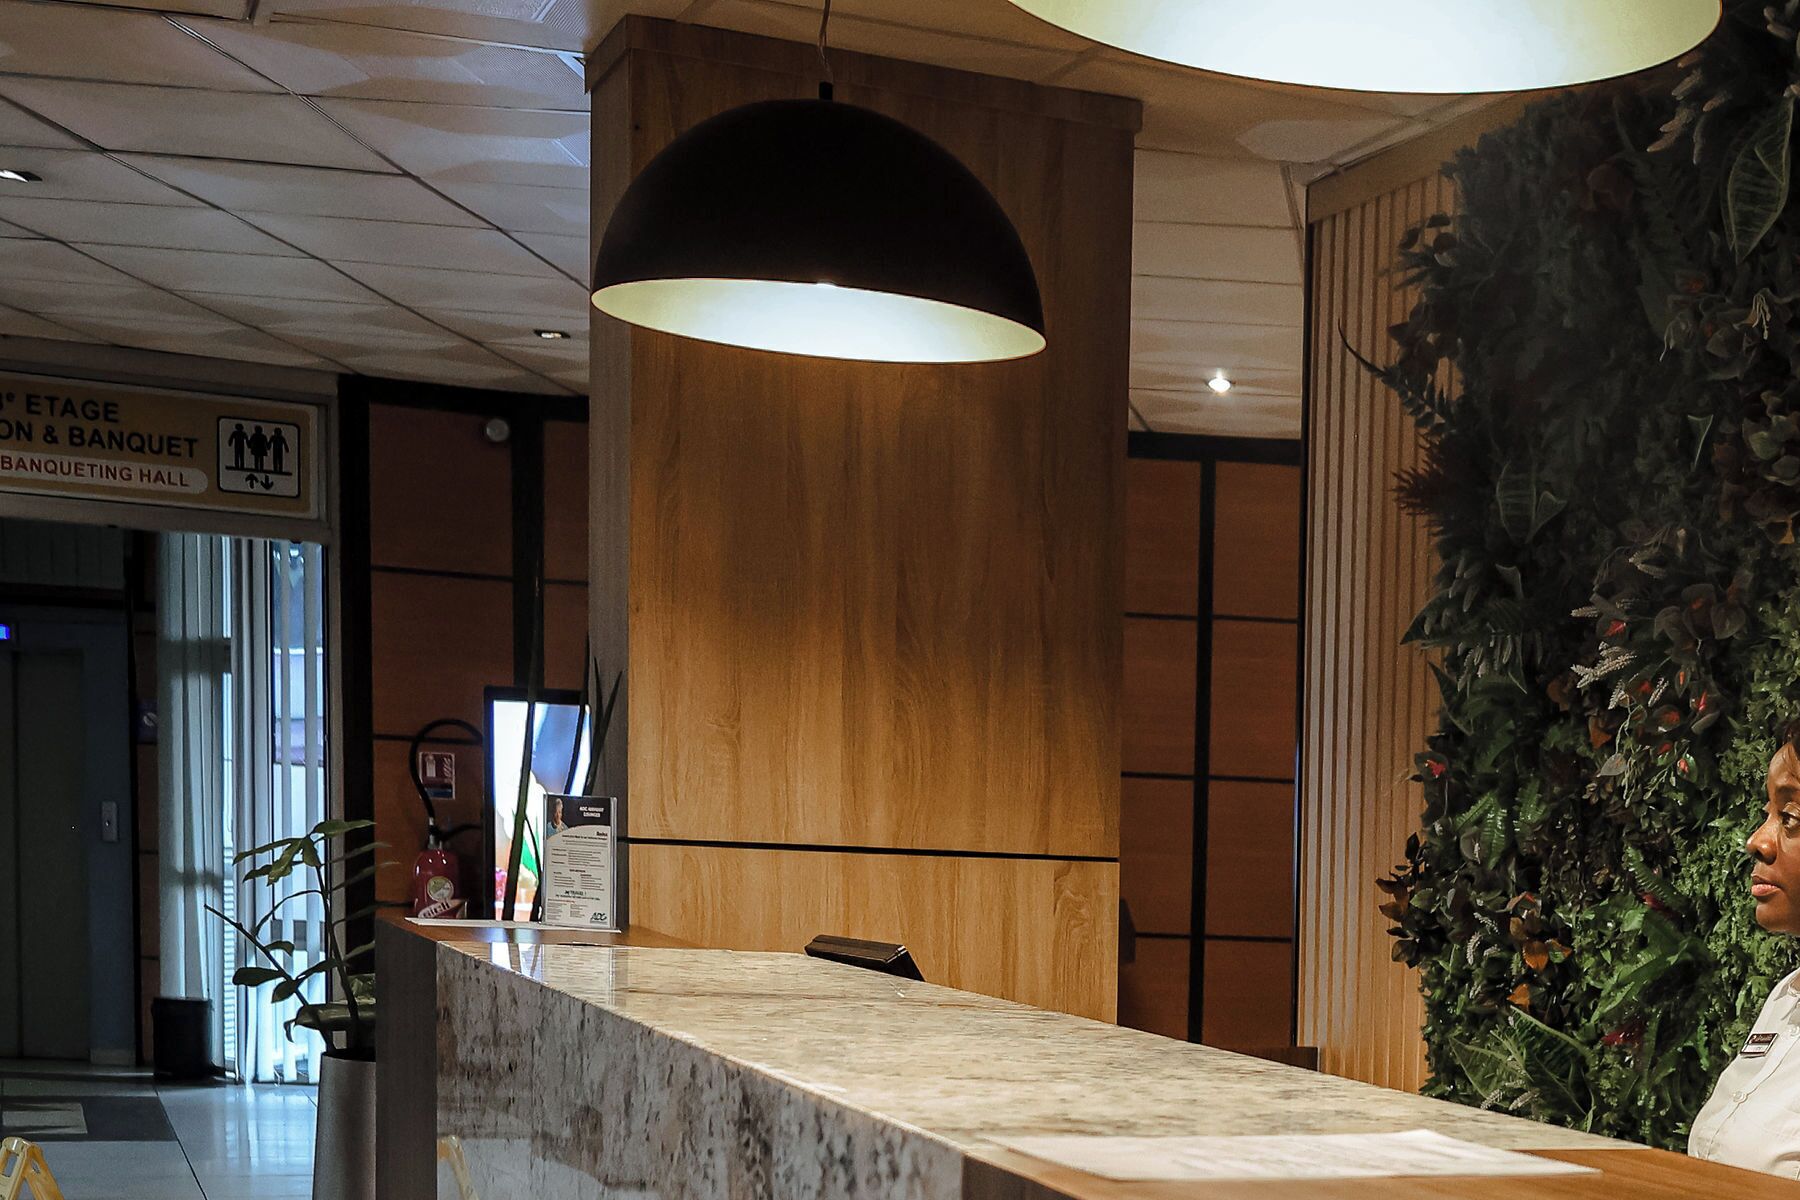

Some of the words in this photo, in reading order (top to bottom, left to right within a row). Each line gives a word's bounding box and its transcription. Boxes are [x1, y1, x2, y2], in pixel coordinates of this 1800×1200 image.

[26, 393, 119, 423] ETAGE
[43, 424, 59, 444] &
[69, 425, 198, 458] BANQUET
[0, 455, 133, 481] BANQUETING
[139, 467, 190, 487] HALL
